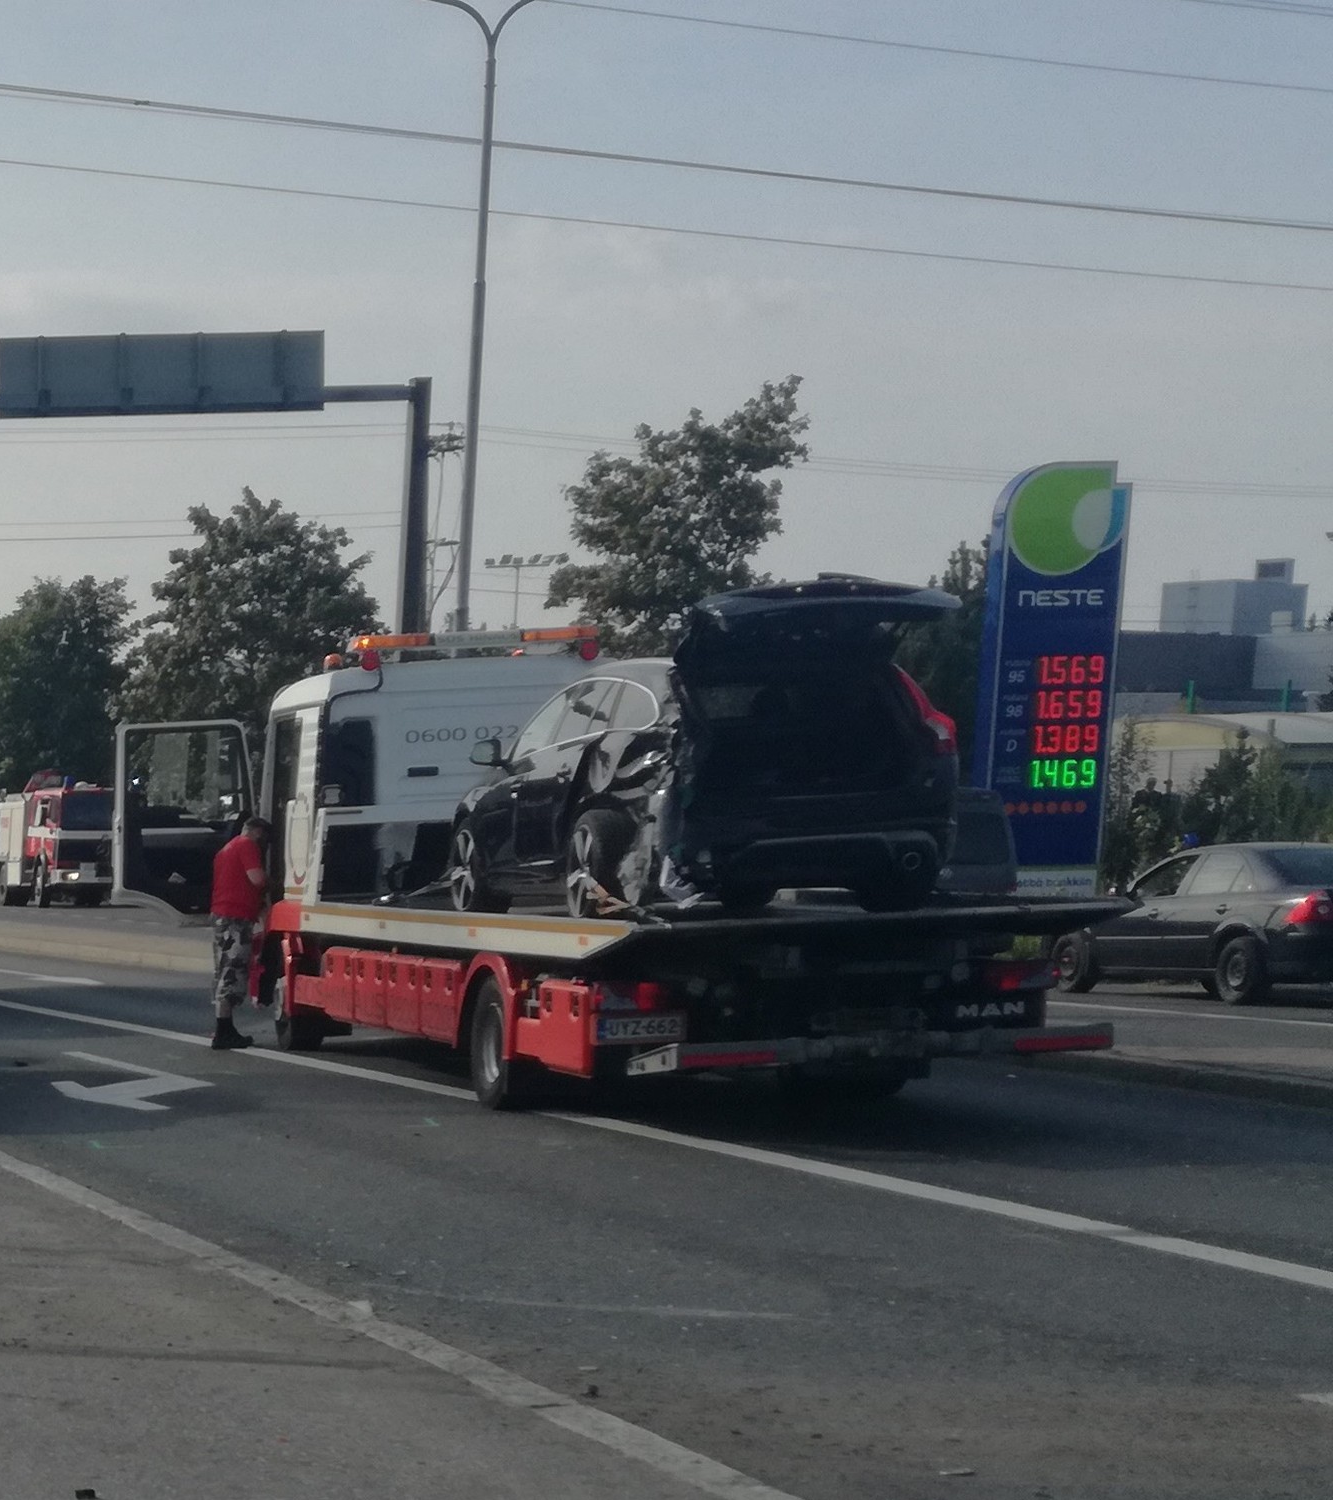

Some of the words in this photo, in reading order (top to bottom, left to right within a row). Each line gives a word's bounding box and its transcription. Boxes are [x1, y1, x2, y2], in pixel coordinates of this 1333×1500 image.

[1018, 589, 1104, 606] NESTE
[1008, 671, 1025, 683] 95
[1040, 655, 1105, 685] 1.569
[1006, 705, 1023, 717] 98
[1037, 690, 1102, 719] 1.659
[405, 727, 467, 743] 0600
[1006, 739, 1017, 752] D
[1034, 724, 1099, 753] 1.389
[1030, 758, 1096, 788] 1.469
[956, 1001, 1025, 1018] MAN
[609, 1018, 678, 1036] UYZ-662
